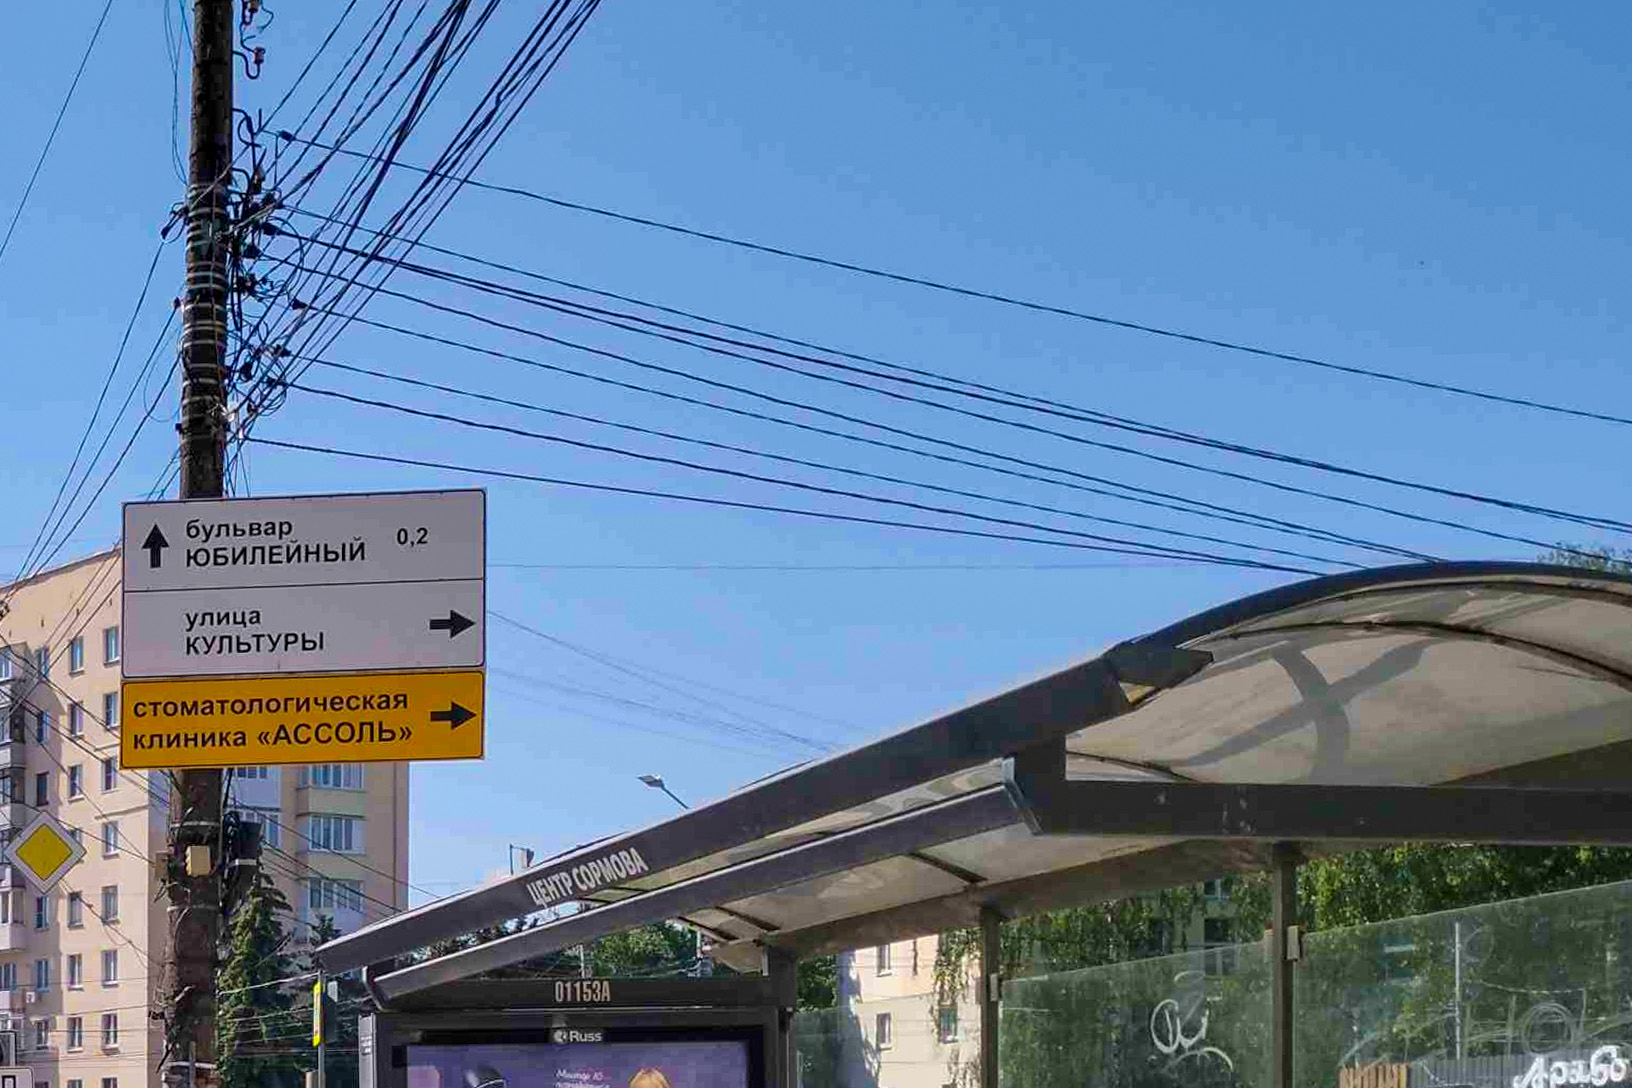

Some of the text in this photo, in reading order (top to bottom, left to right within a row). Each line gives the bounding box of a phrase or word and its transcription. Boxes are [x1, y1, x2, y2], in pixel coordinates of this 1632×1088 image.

[186, 519, 294, 541] бульвар
[397, 527, 429, 548] 0,2
[186, 537, 367, 568] ЮБИЛЕЙНЫЙ
[186, 609, 261, 632] улица
[186, 631, 325, 656] КУЛЬТУРЫ
[133, 692, 409, 718] стоматологическая
[133, 721, 413, 751] клиника «АССОЛЬ»
[526, 847, 649, 908] ЦЕНТР СОРМОВА
[555, 981, 611, 1003] 01153A
[569, 1030, 603, 1043] Russ
